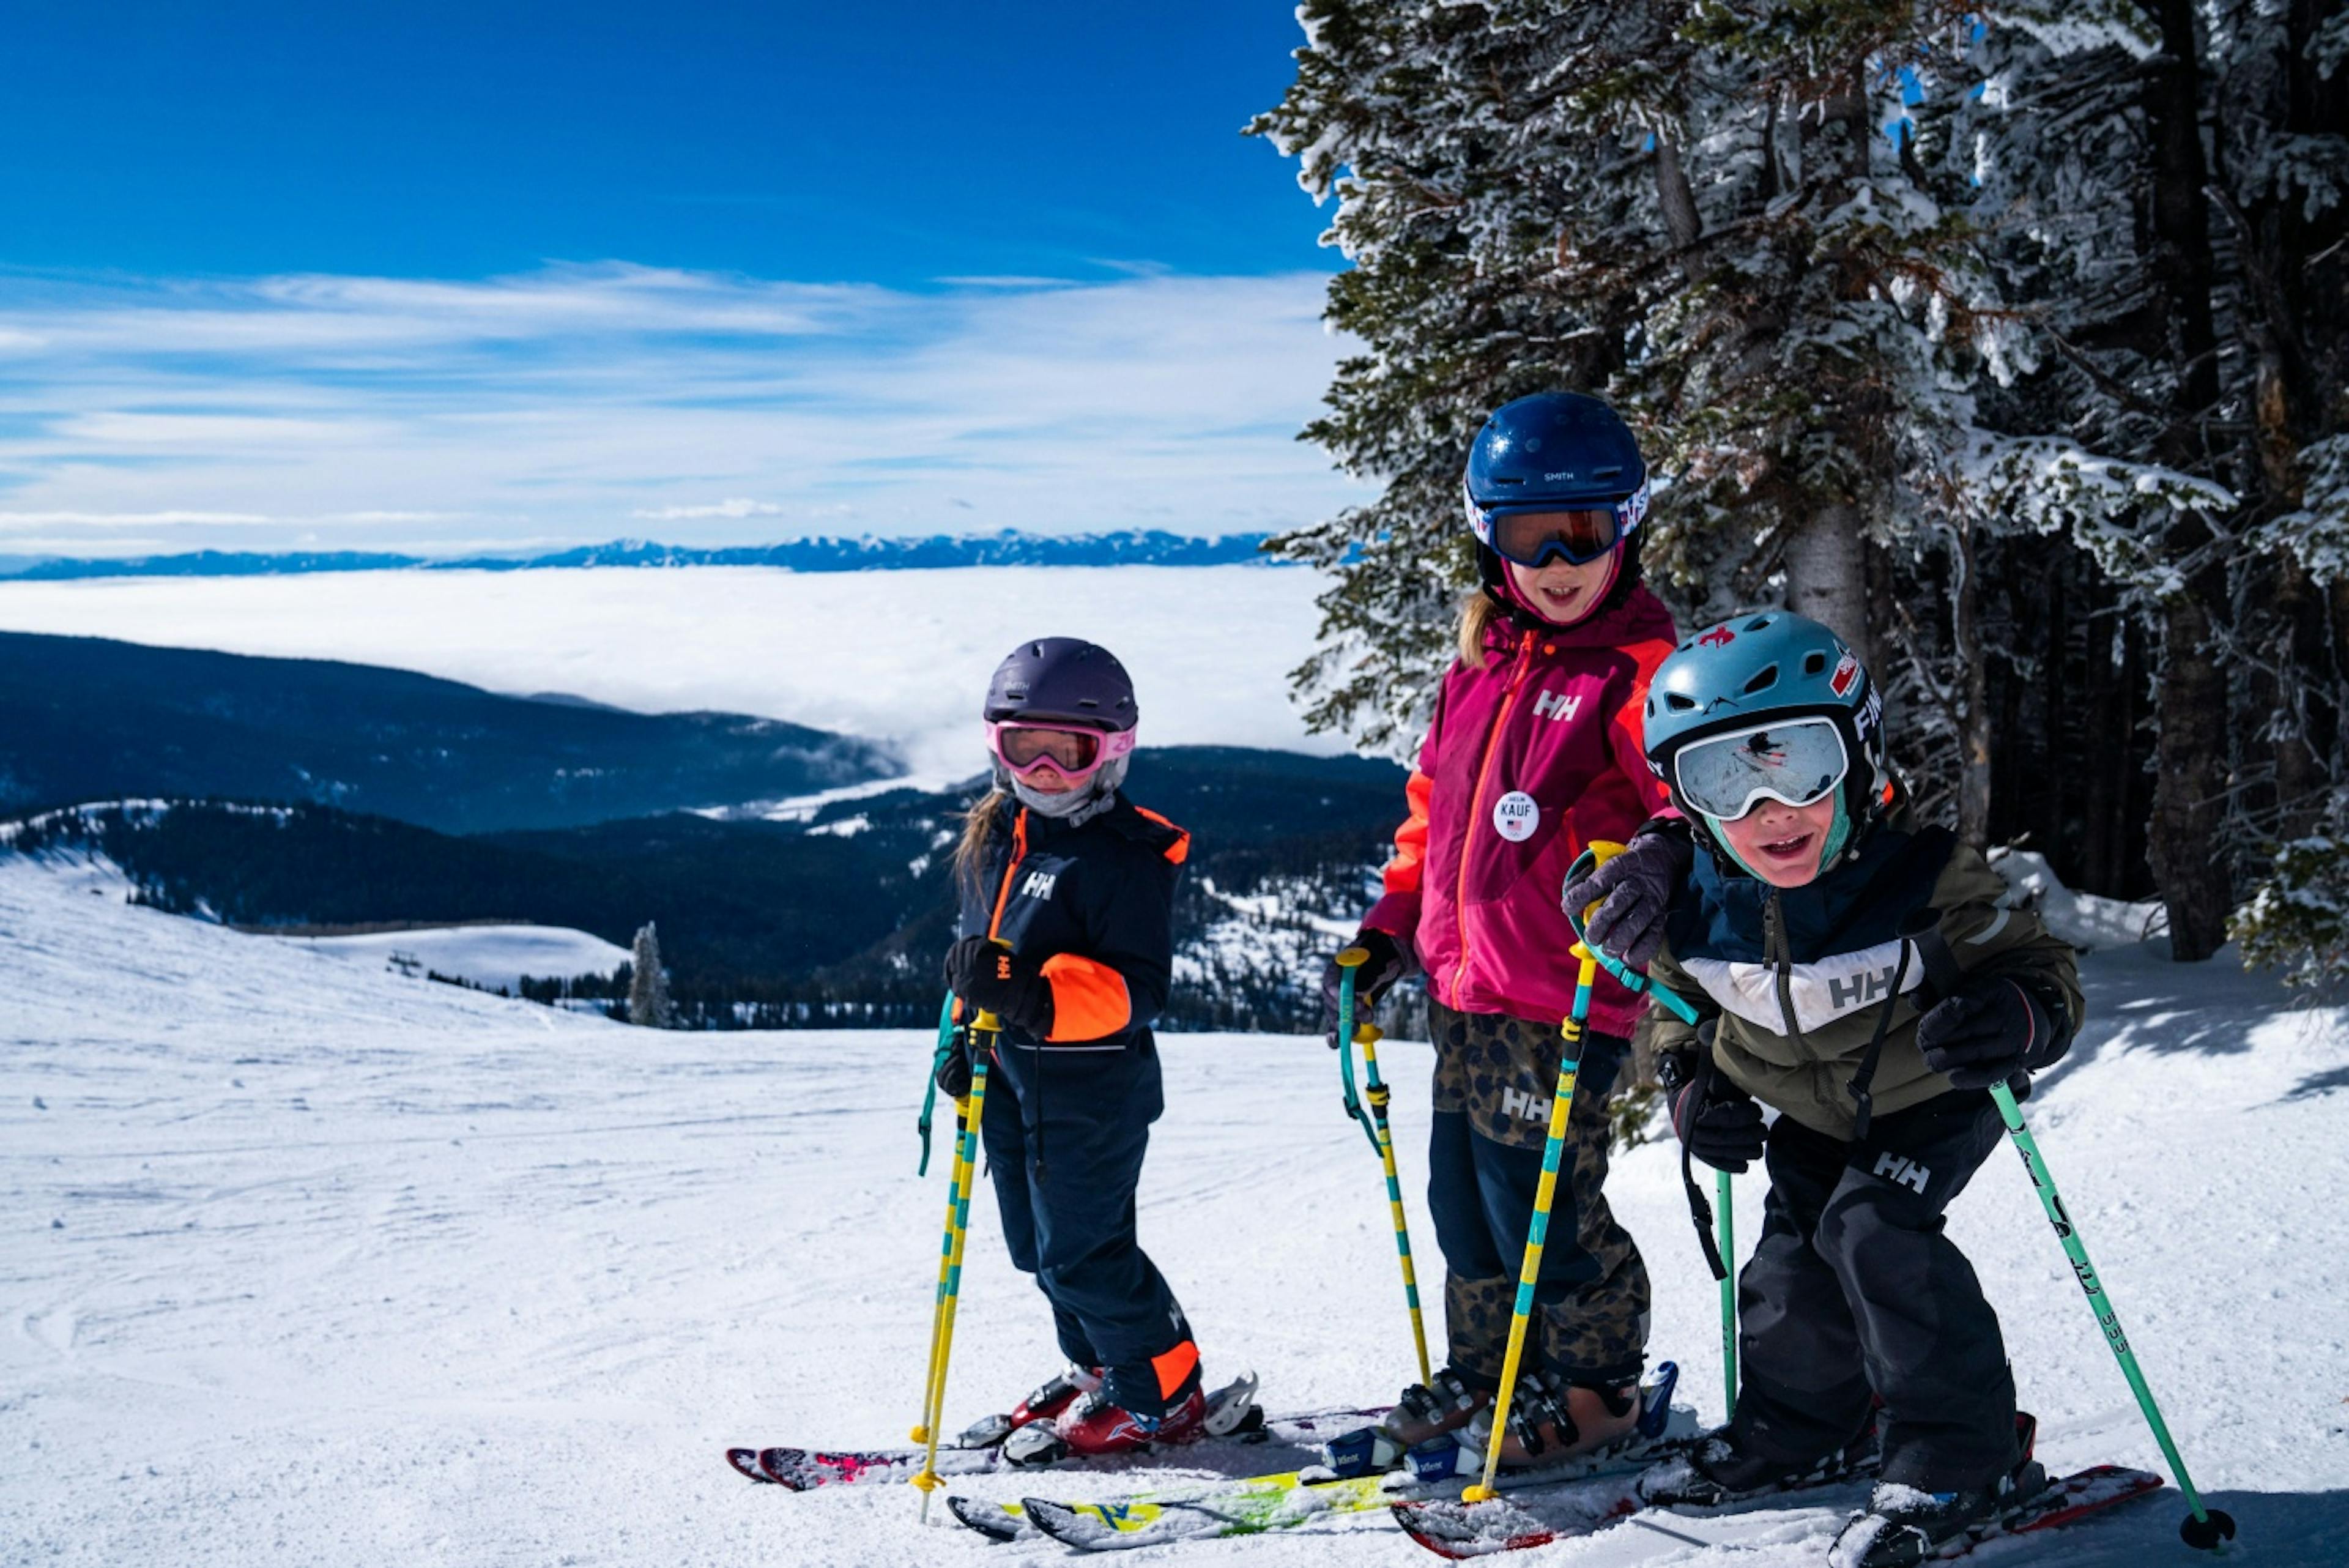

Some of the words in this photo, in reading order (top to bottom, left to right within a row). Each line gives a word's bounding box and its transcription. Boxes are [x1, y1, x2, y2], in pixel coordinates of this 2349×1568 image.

[1543, 472, 1574, 482] SMITH
[1532, 689, 1582, 722] HH
[1500, 803, 1531, 817] KAUF
[1022, 871, 1056, 901] HH
[998, 954, 1011, 979] HH
[1828, 966, 1895, 1009] HH
[1501, 1085, 1553, 1124] HH
[1873, 1151, 1931, 1195] HH
